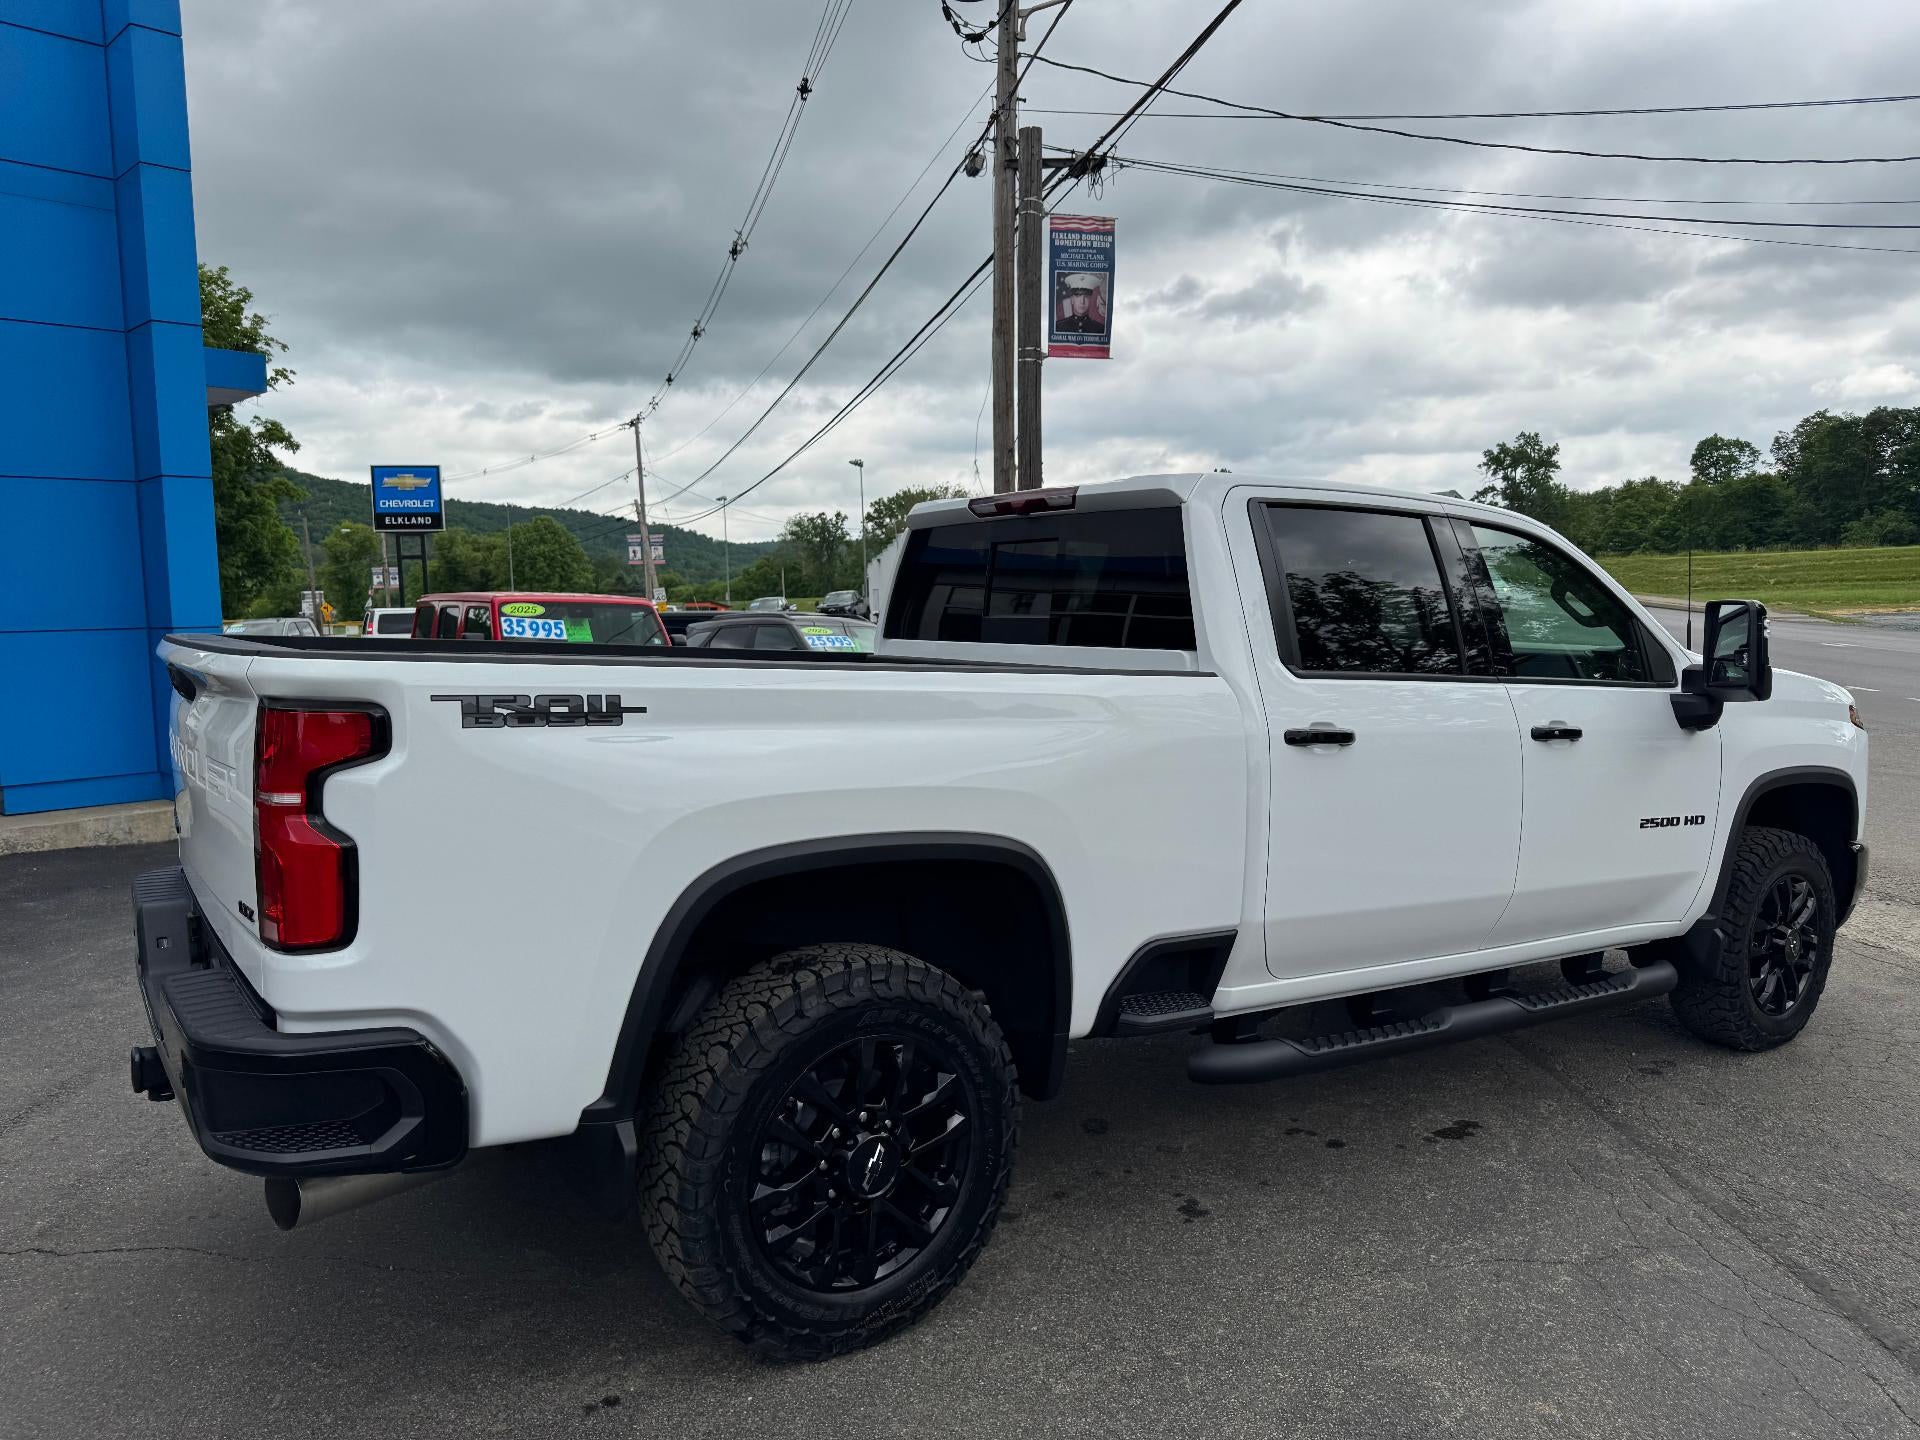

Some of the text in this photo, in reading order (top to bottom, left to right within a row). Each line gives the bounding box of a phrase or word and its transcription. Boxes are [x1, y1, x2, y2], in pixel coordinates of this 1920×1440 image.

[1054, 239, 1110, 249] HOMETOWN HERO
[379, 499, 435, 508] CHEVROLET
[385, 516, 432, 525] ELKLAND
[510, 605, 538, 614] 2025
[503, 618, 564, 638] 35995
[807, 636, 853, 647] 25995
[461, 711, 624, 729] BOSS
[1639, 814, 1706, 829] 2500 HD
